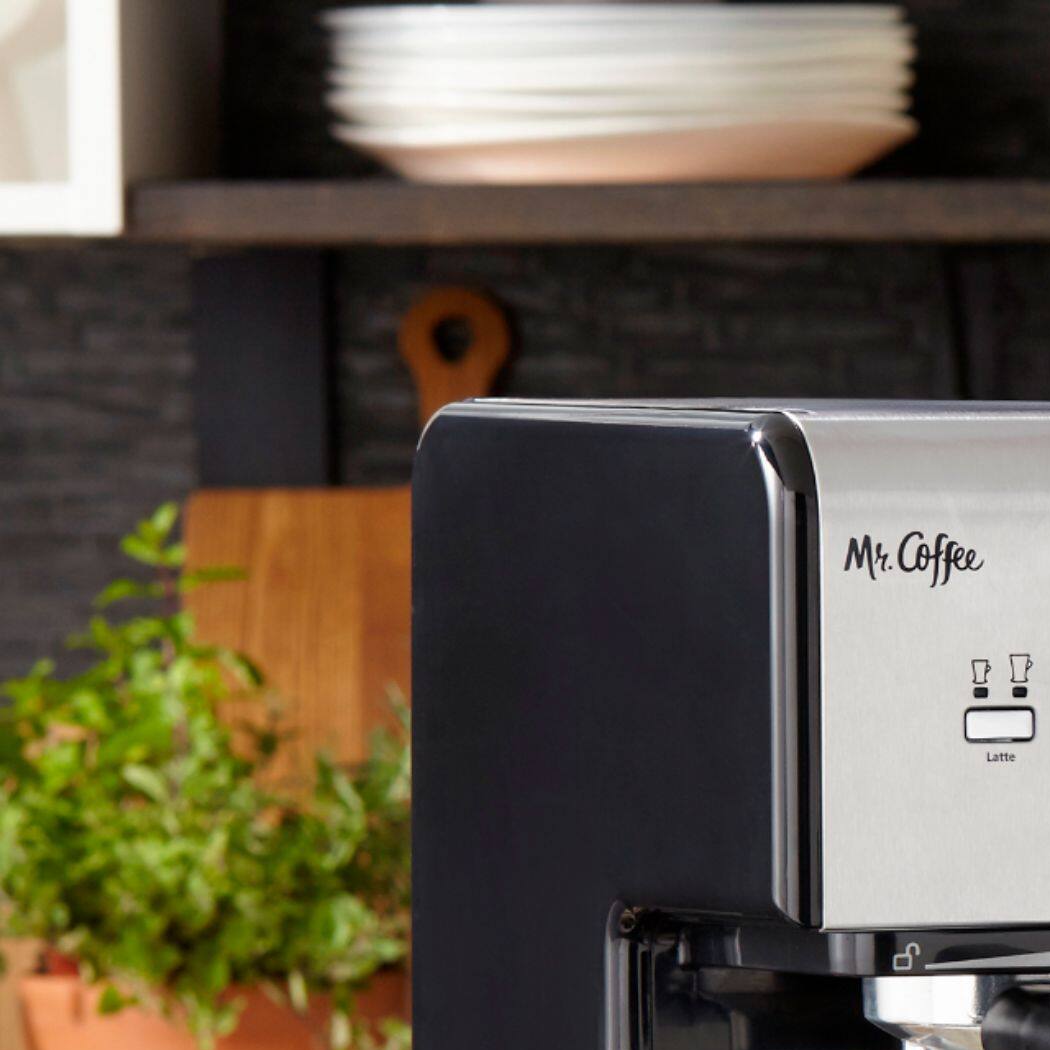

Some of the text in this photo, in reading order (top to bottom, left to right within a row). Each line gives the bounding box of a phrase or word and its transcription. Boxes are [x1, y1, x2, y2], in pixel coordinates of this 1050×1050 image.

[843, 531, 985, 588] Mr. Coffee
[986, 751, 1017, 763] Latte
